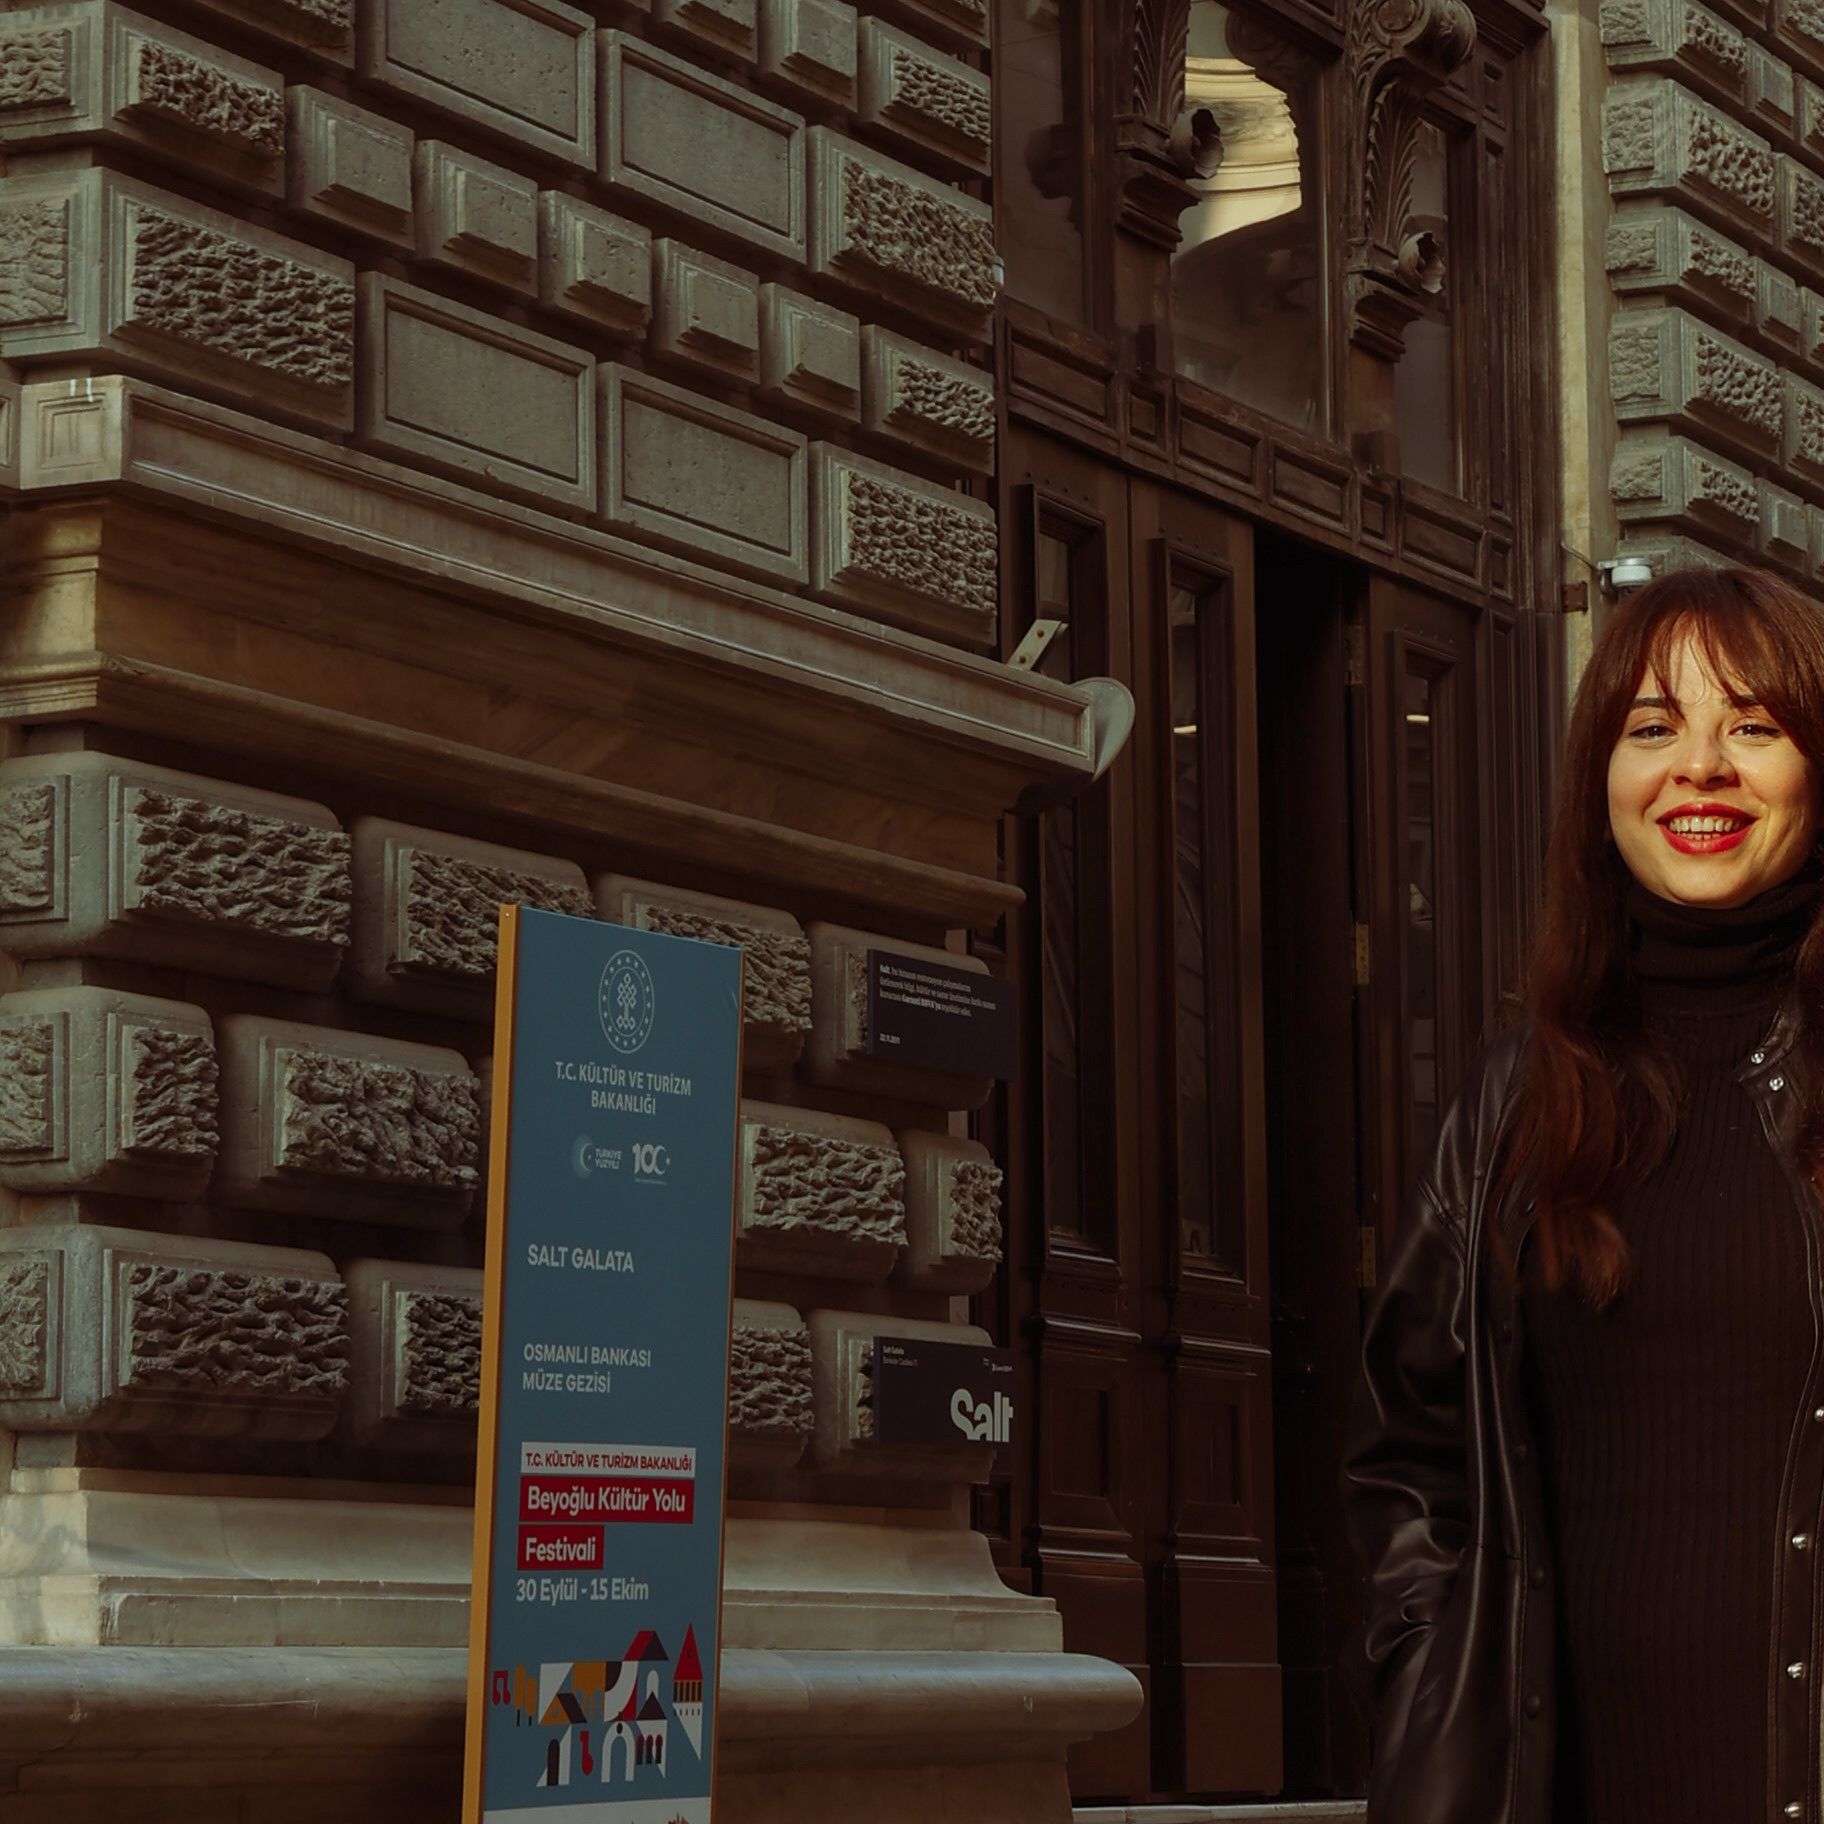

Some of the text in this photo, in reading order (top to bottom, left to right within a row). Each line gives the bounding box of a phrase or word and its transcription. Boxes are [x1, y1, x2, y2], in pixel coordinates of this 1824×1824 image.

[555, 1061, 692, 1097] T.C. KÜLTÜR VE TURİZM
[591, 1090, 656, 1115] BAKANLIĞI
[527, 1243, 635, 1273] SALT GALATA
[523, 1342, 651, 1367] OSMANLI BANKASI
[522, 1368, 611, 1393] MÜZE GEZİSİ
[950, 1388, 1013, 1442] Salt
[526, 1450, 692, 1471] T.C. KÜLTÜR VE TURİZM BAKANLIĞI
[527, 1484, 686, 1517] Beyoğlu Kültür Yolu
[525, 1536, 596, 1562] Festivali
[516, 1578, 537, 1602] 30
[540, 1577, 578, 1606] Eylül
[590, 1578, 608, 1601] 15
[611, 1577, 649, 1601] Ekim
